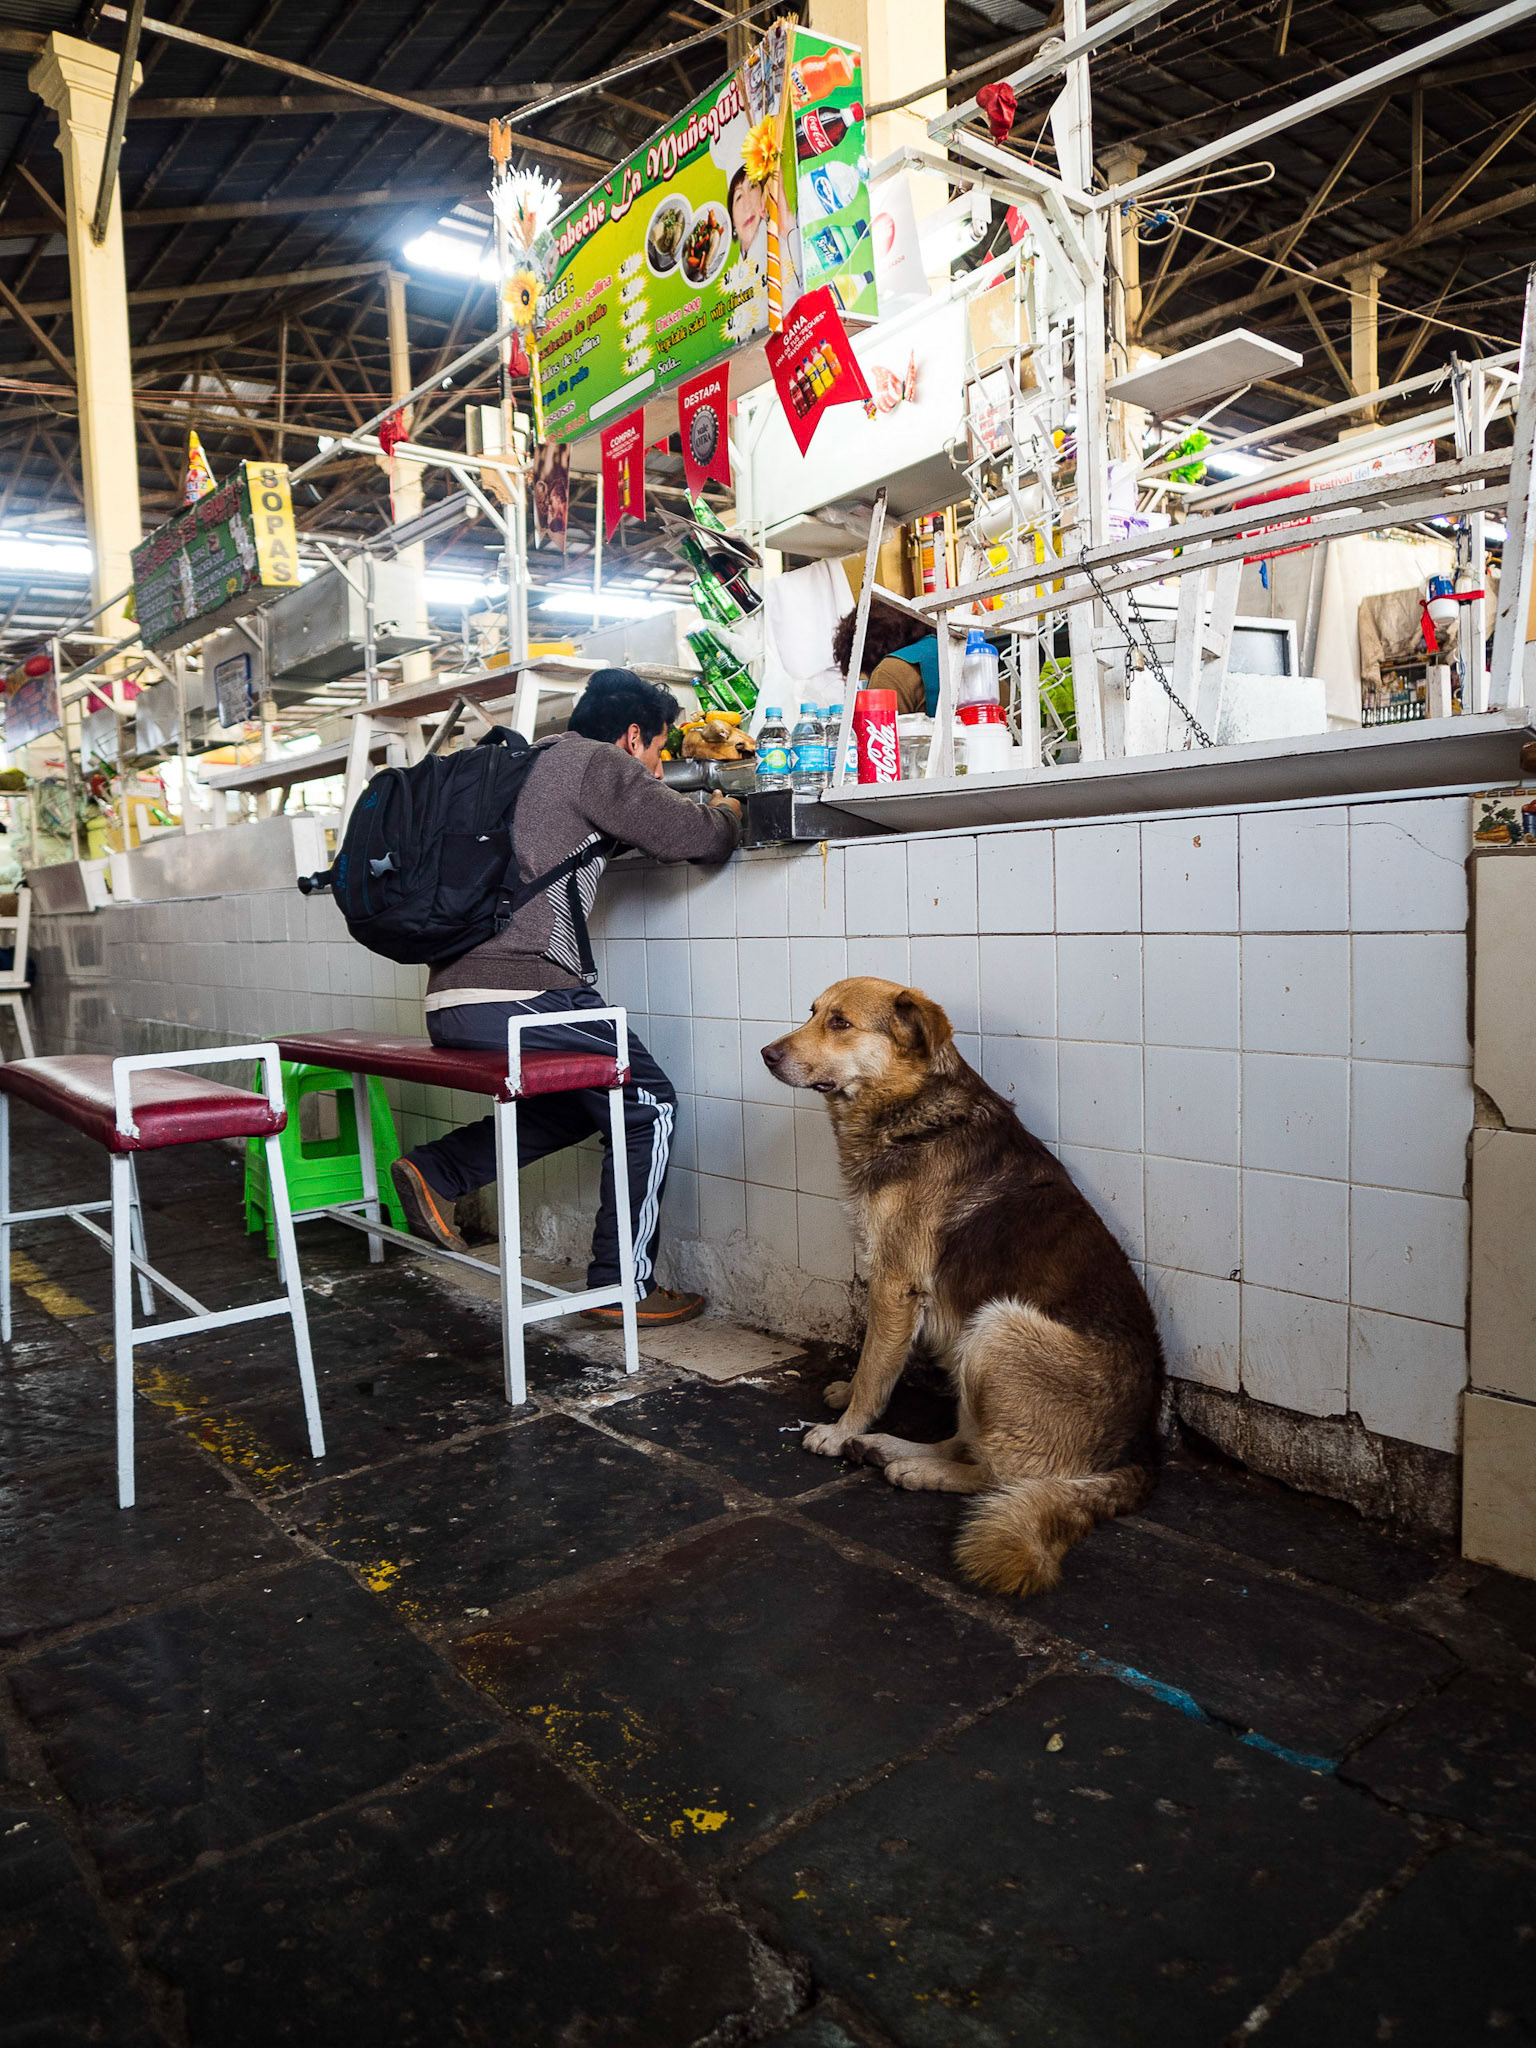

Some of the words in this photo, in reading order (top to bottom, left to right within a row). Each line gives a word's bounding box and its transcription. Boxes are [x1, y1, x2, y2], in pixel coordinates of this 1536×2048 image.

[545, 279, 568, 312] RECE
[573, 297, 584, 313] de
[585, 275, 612, 305] gallina
[574, 318, 585, 336] de
[586, 304, 608, 330] pollo
[654, 308, 682, 334] Chicken
[656, 326, 688, 354] Vegetable
[688, 312, 708, 335] salad
[710, 301, 726, 323] with
[727, 287, 755, 313] chicken
[782, 315, 808, 346] GANA
[541, 361, 561, 383] aldos
[562, 353, 573, 369] de
[574, 334, 600, 363] gallina
[784, 346, 792, 358] DE
[789, 336, 801, 351] TUS
[787, 331, 814, 360] FAVORITAS
[684, 381, 721, 409] DESTAPA
[544, 400, 575, 426] aseosas
[610, 426, 636, 448] COMPRA
[695, 432, 712, 448] OTRA
[696, 424, 709, 435] vale
[1313, 472, 1354, 490] Festival
[1355, 466, 1371, 481] del
[260, 468, 292, 582] SOPAS
